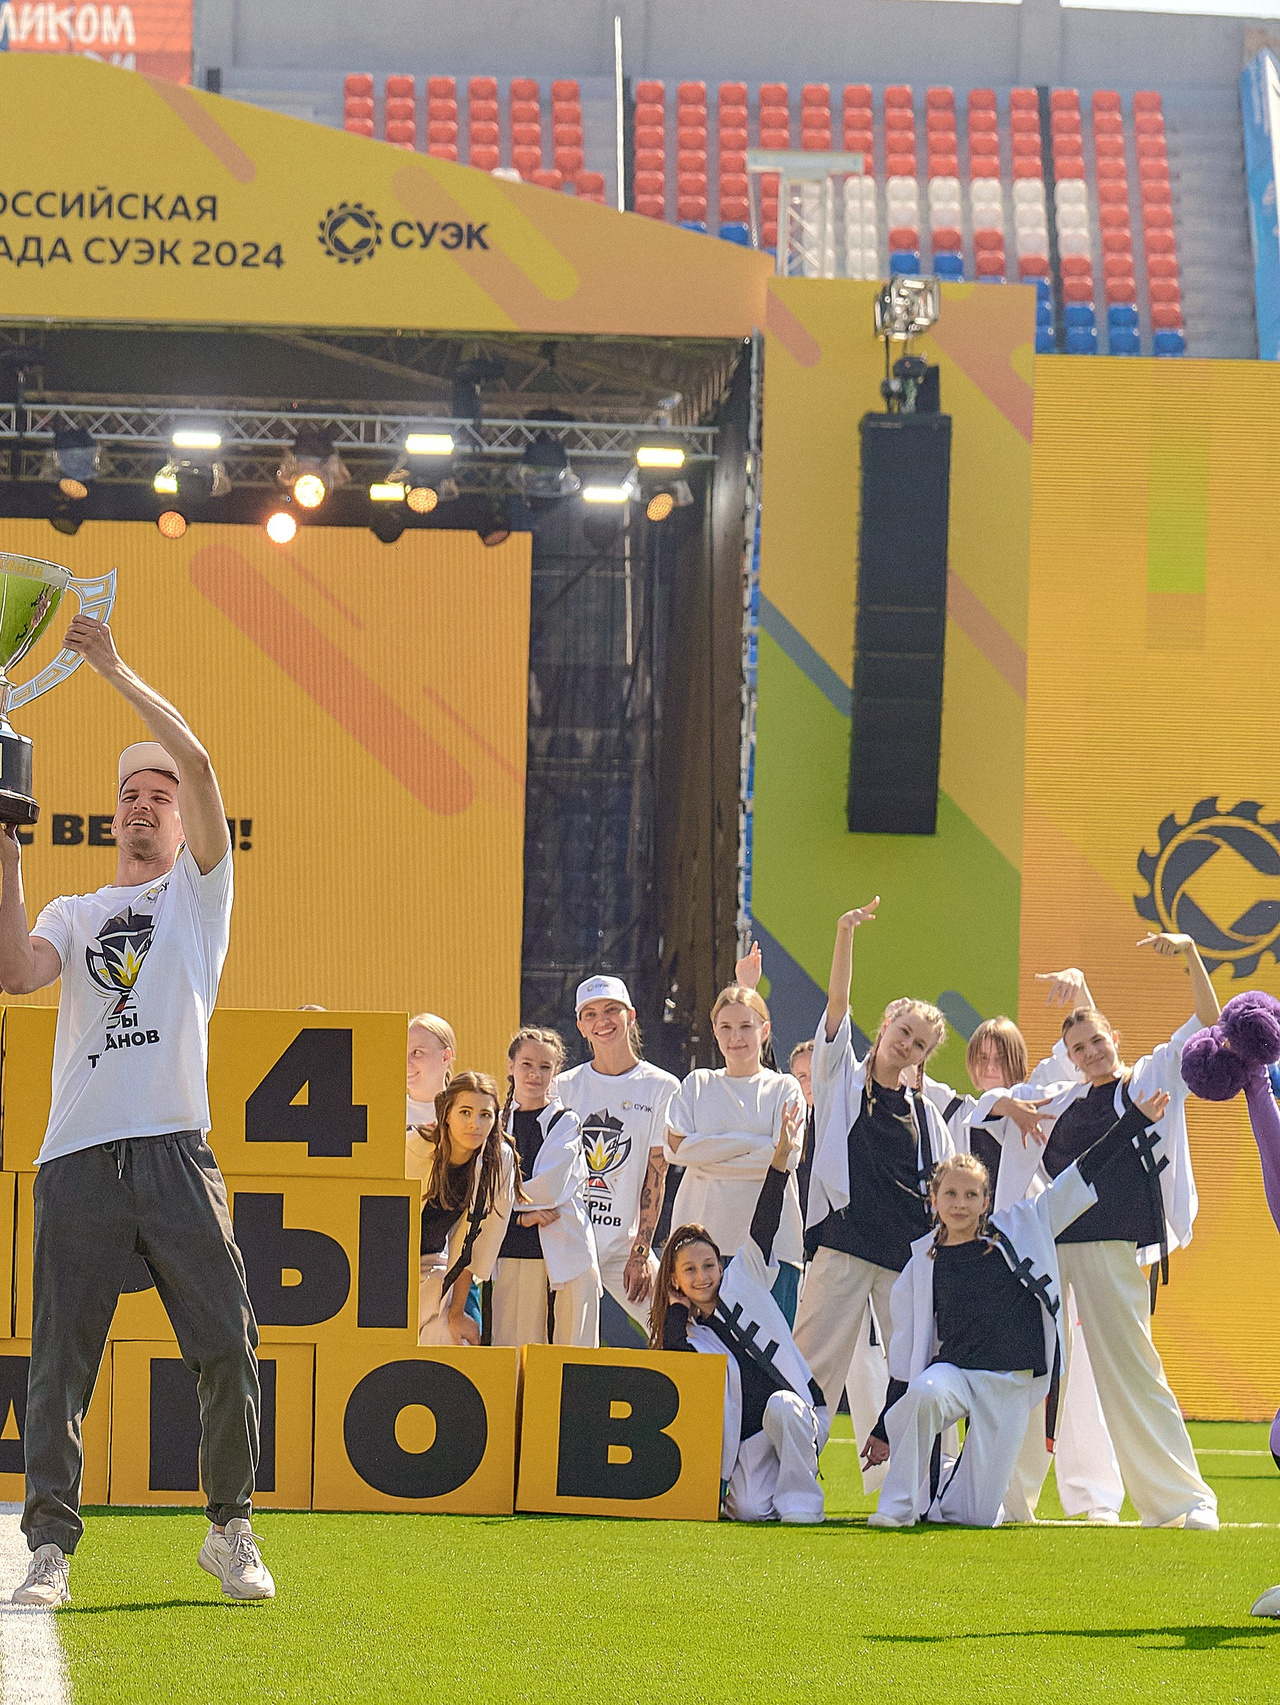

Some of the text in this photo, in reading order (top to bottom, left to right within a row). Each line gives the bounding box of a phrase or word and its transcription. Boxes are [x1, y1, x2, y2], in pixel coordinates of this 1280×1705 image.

[390, 221, 490, 251] СУЭК
[83, 236, 181, 267] СУЭК
[192, 240, 286, 268] 2024
